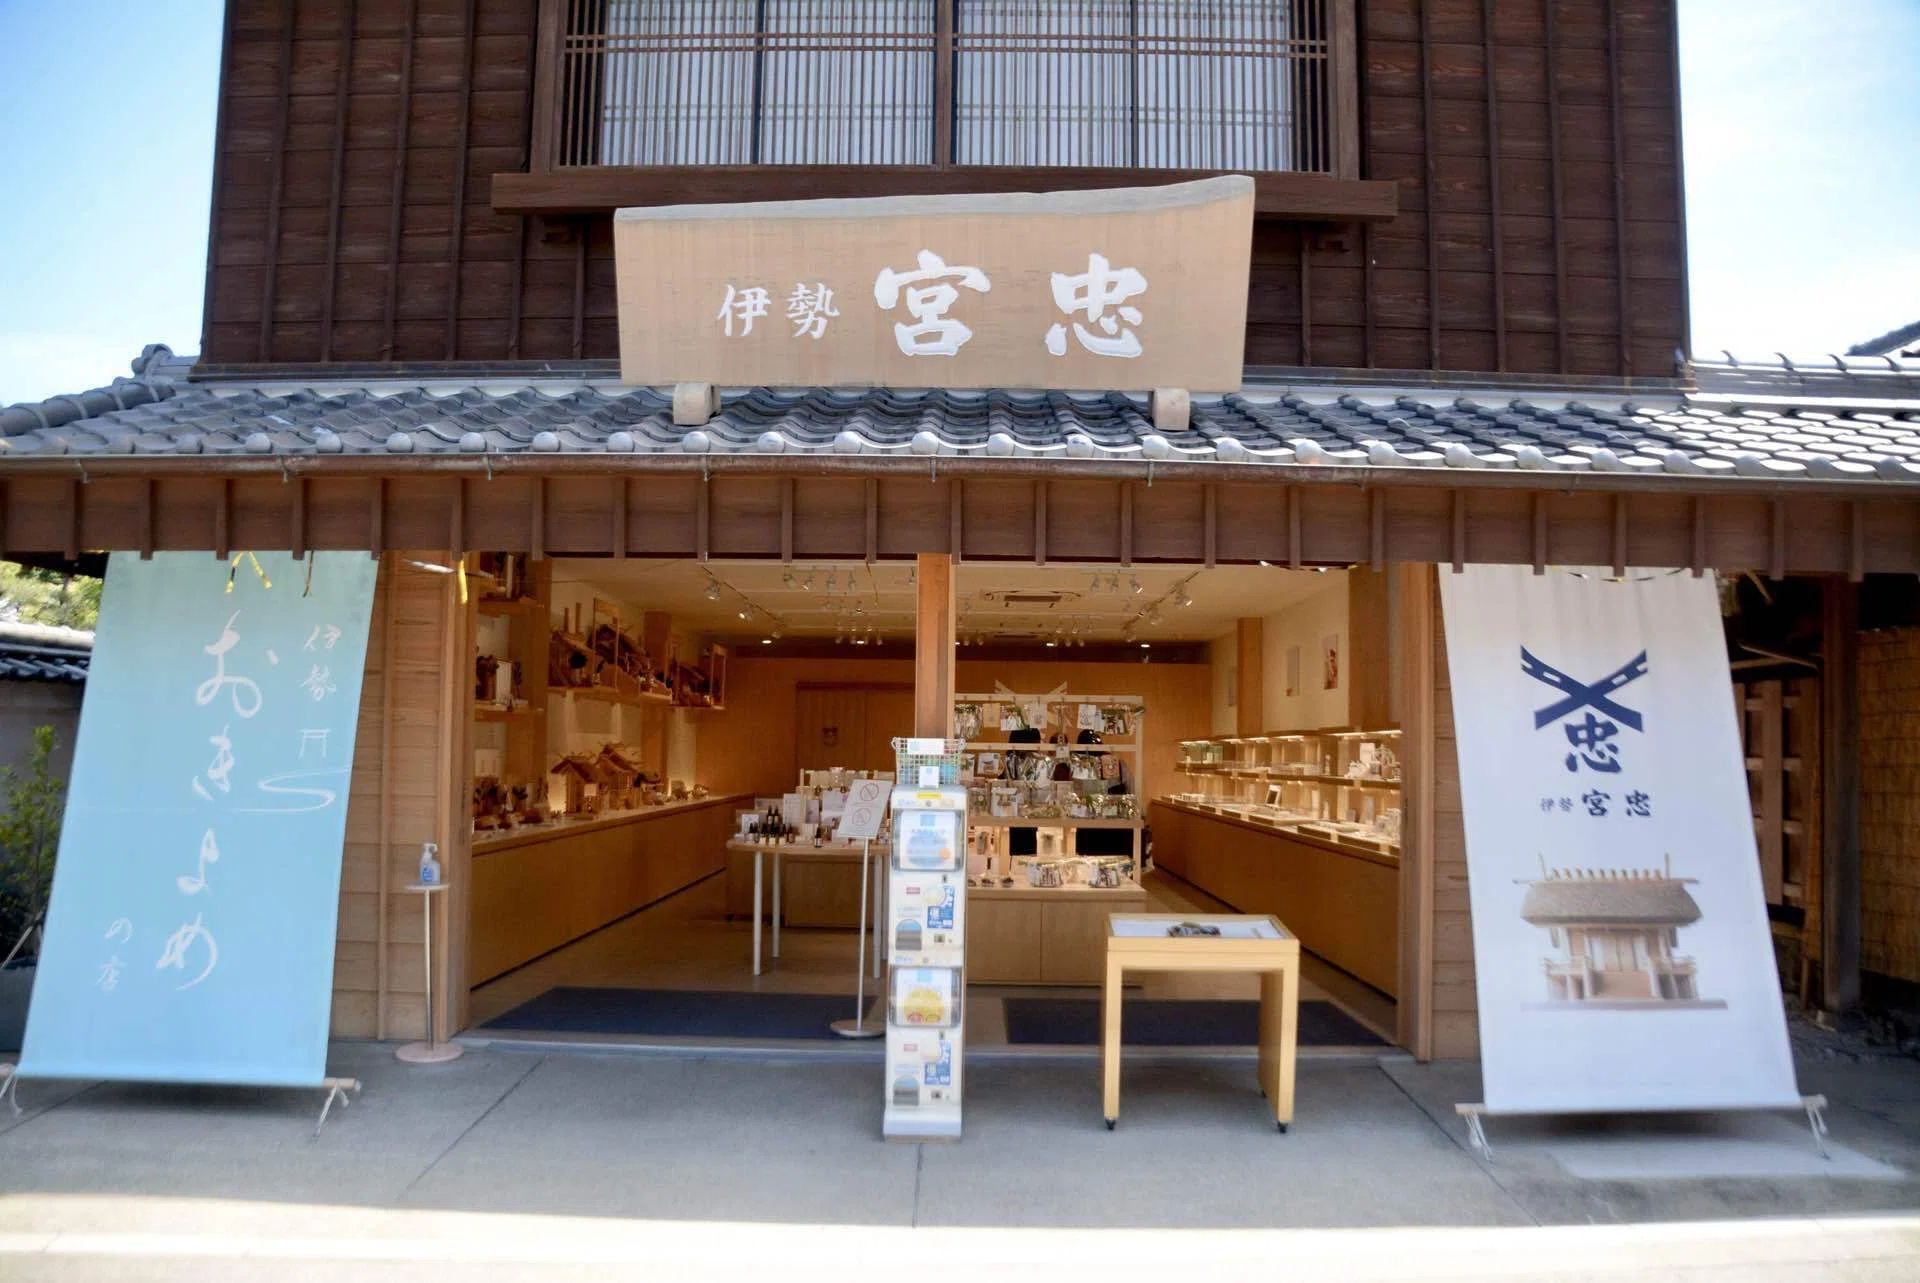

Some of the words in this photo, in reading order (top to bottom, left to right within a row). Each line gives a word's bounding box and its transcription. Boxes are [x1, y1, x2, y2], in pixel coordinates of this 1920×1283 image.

[717, 281, 841, 340] 伊勢
[874, 248, 1148, 359] 宮忠
[300, 623, 343, 702] 伊勢
[1564, 711, 1623, 773] 忠
[155, 608, 279, 991] おきよめ
[1581, 788, 1652, 817] 宮忠
